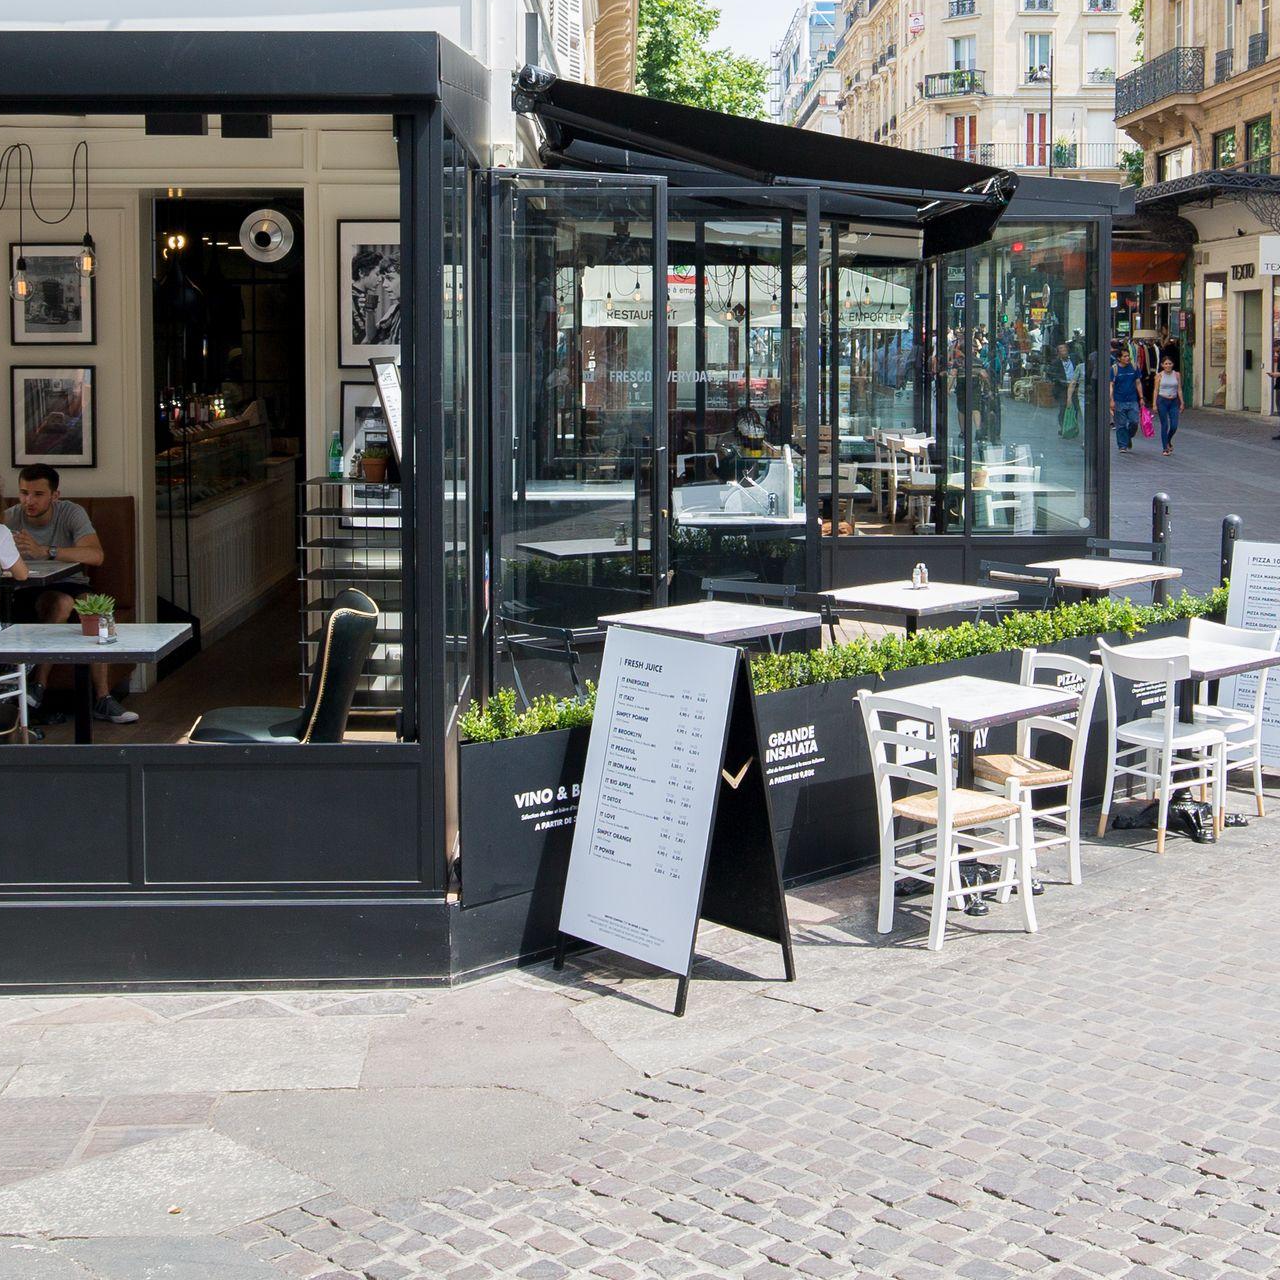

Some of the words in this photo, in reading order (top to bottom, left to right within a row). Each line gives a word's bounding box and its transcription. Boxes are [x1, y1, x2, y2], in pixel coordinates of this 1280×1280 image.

[1231, 263, 1255, 280] TEXTO
[1252, 556, 1270, 564] PIZZA
[624, 658, 644, 670] FRESH
[645, 663, 663, 673] JUICE
[1057, 672, 1083, 687] PIZZA
[768, 725, 814, 747] GRANDE
[766, 740, 819, 763] INSALATA
[514, 788, 554, 808] VINO
[557, 786, 567, 800] &
[535, 823, 540, 831] A
[541, 818, 563, 829] PARTIR
